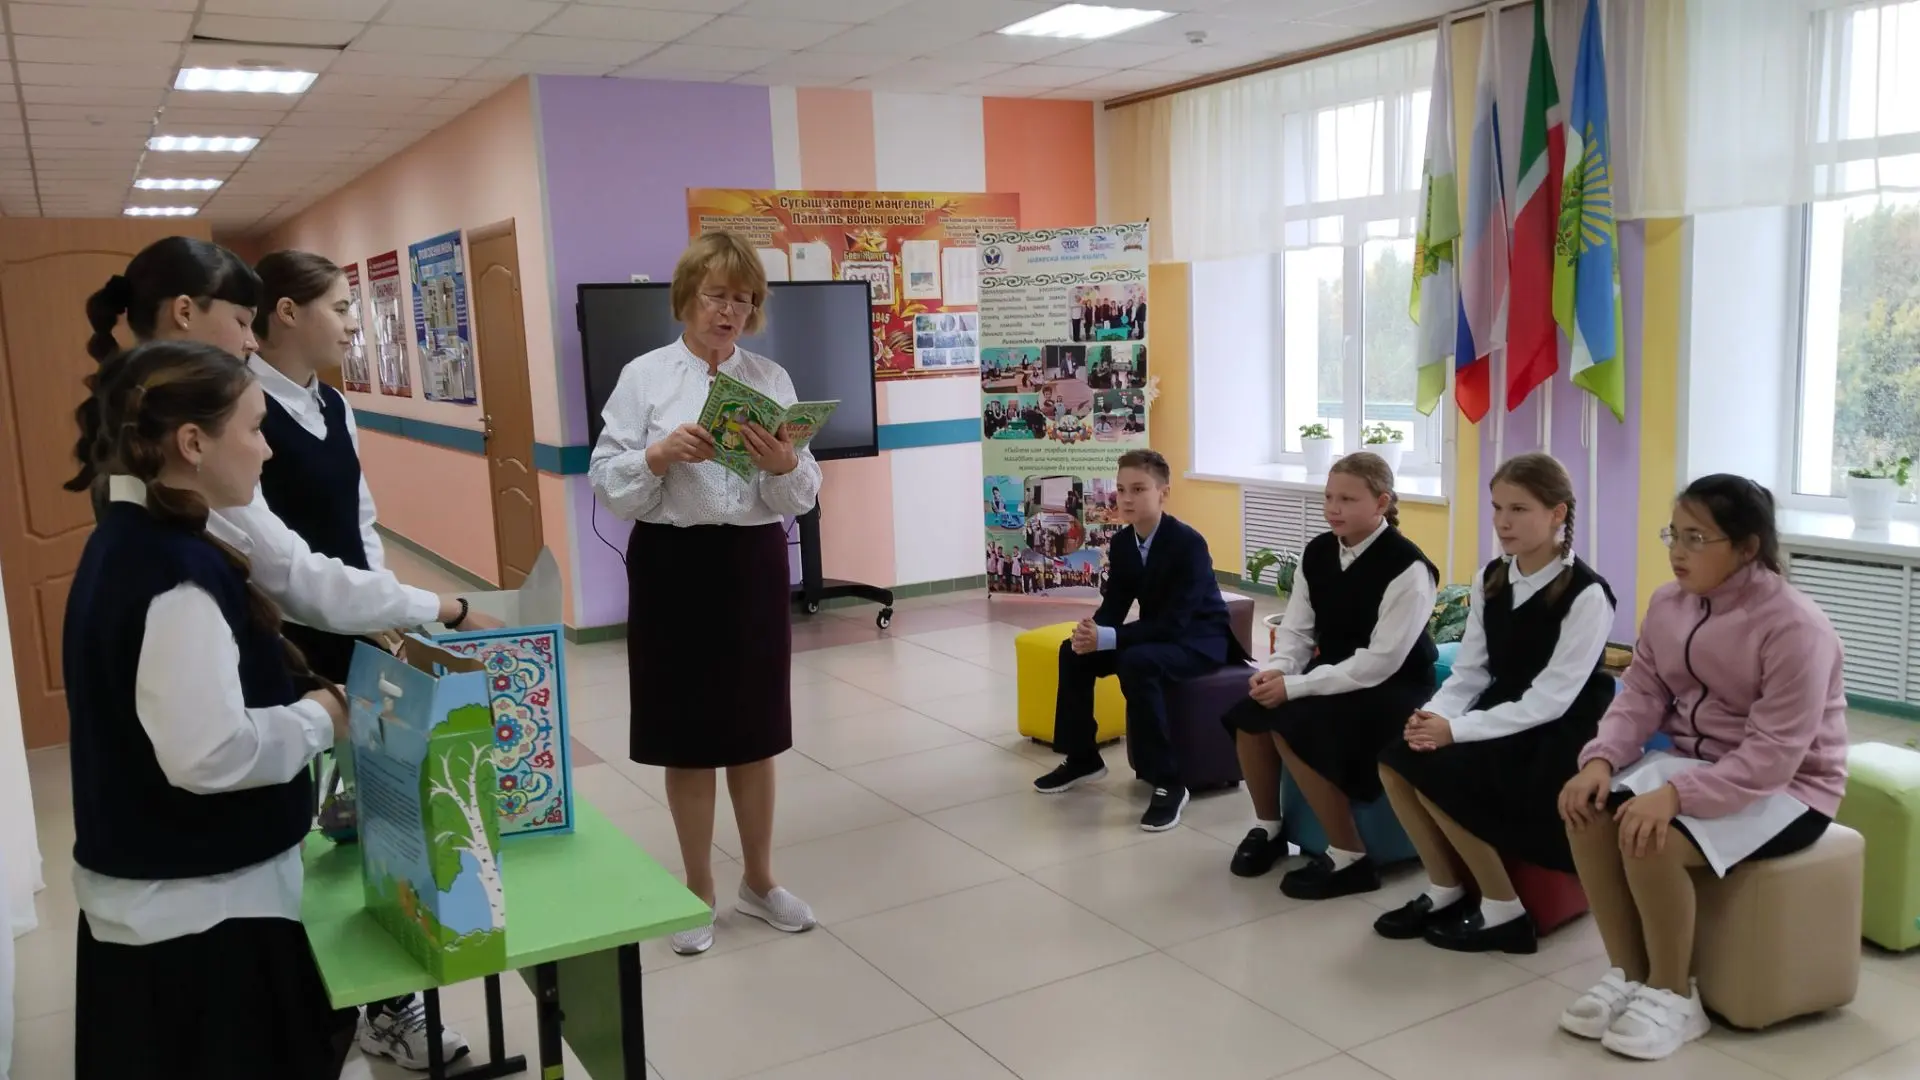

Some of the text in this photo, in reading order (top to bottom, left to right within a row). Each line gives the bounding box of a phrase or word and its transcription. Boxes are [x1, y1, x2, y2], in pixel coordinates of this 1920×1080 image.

[780, 196, 935, 211] Сугыш хәтере мәңгелек!
[792, 213, 843, 224] Память
[887, 213, 925, 224] вечна!
[872, 311, 891, 324] 1945
